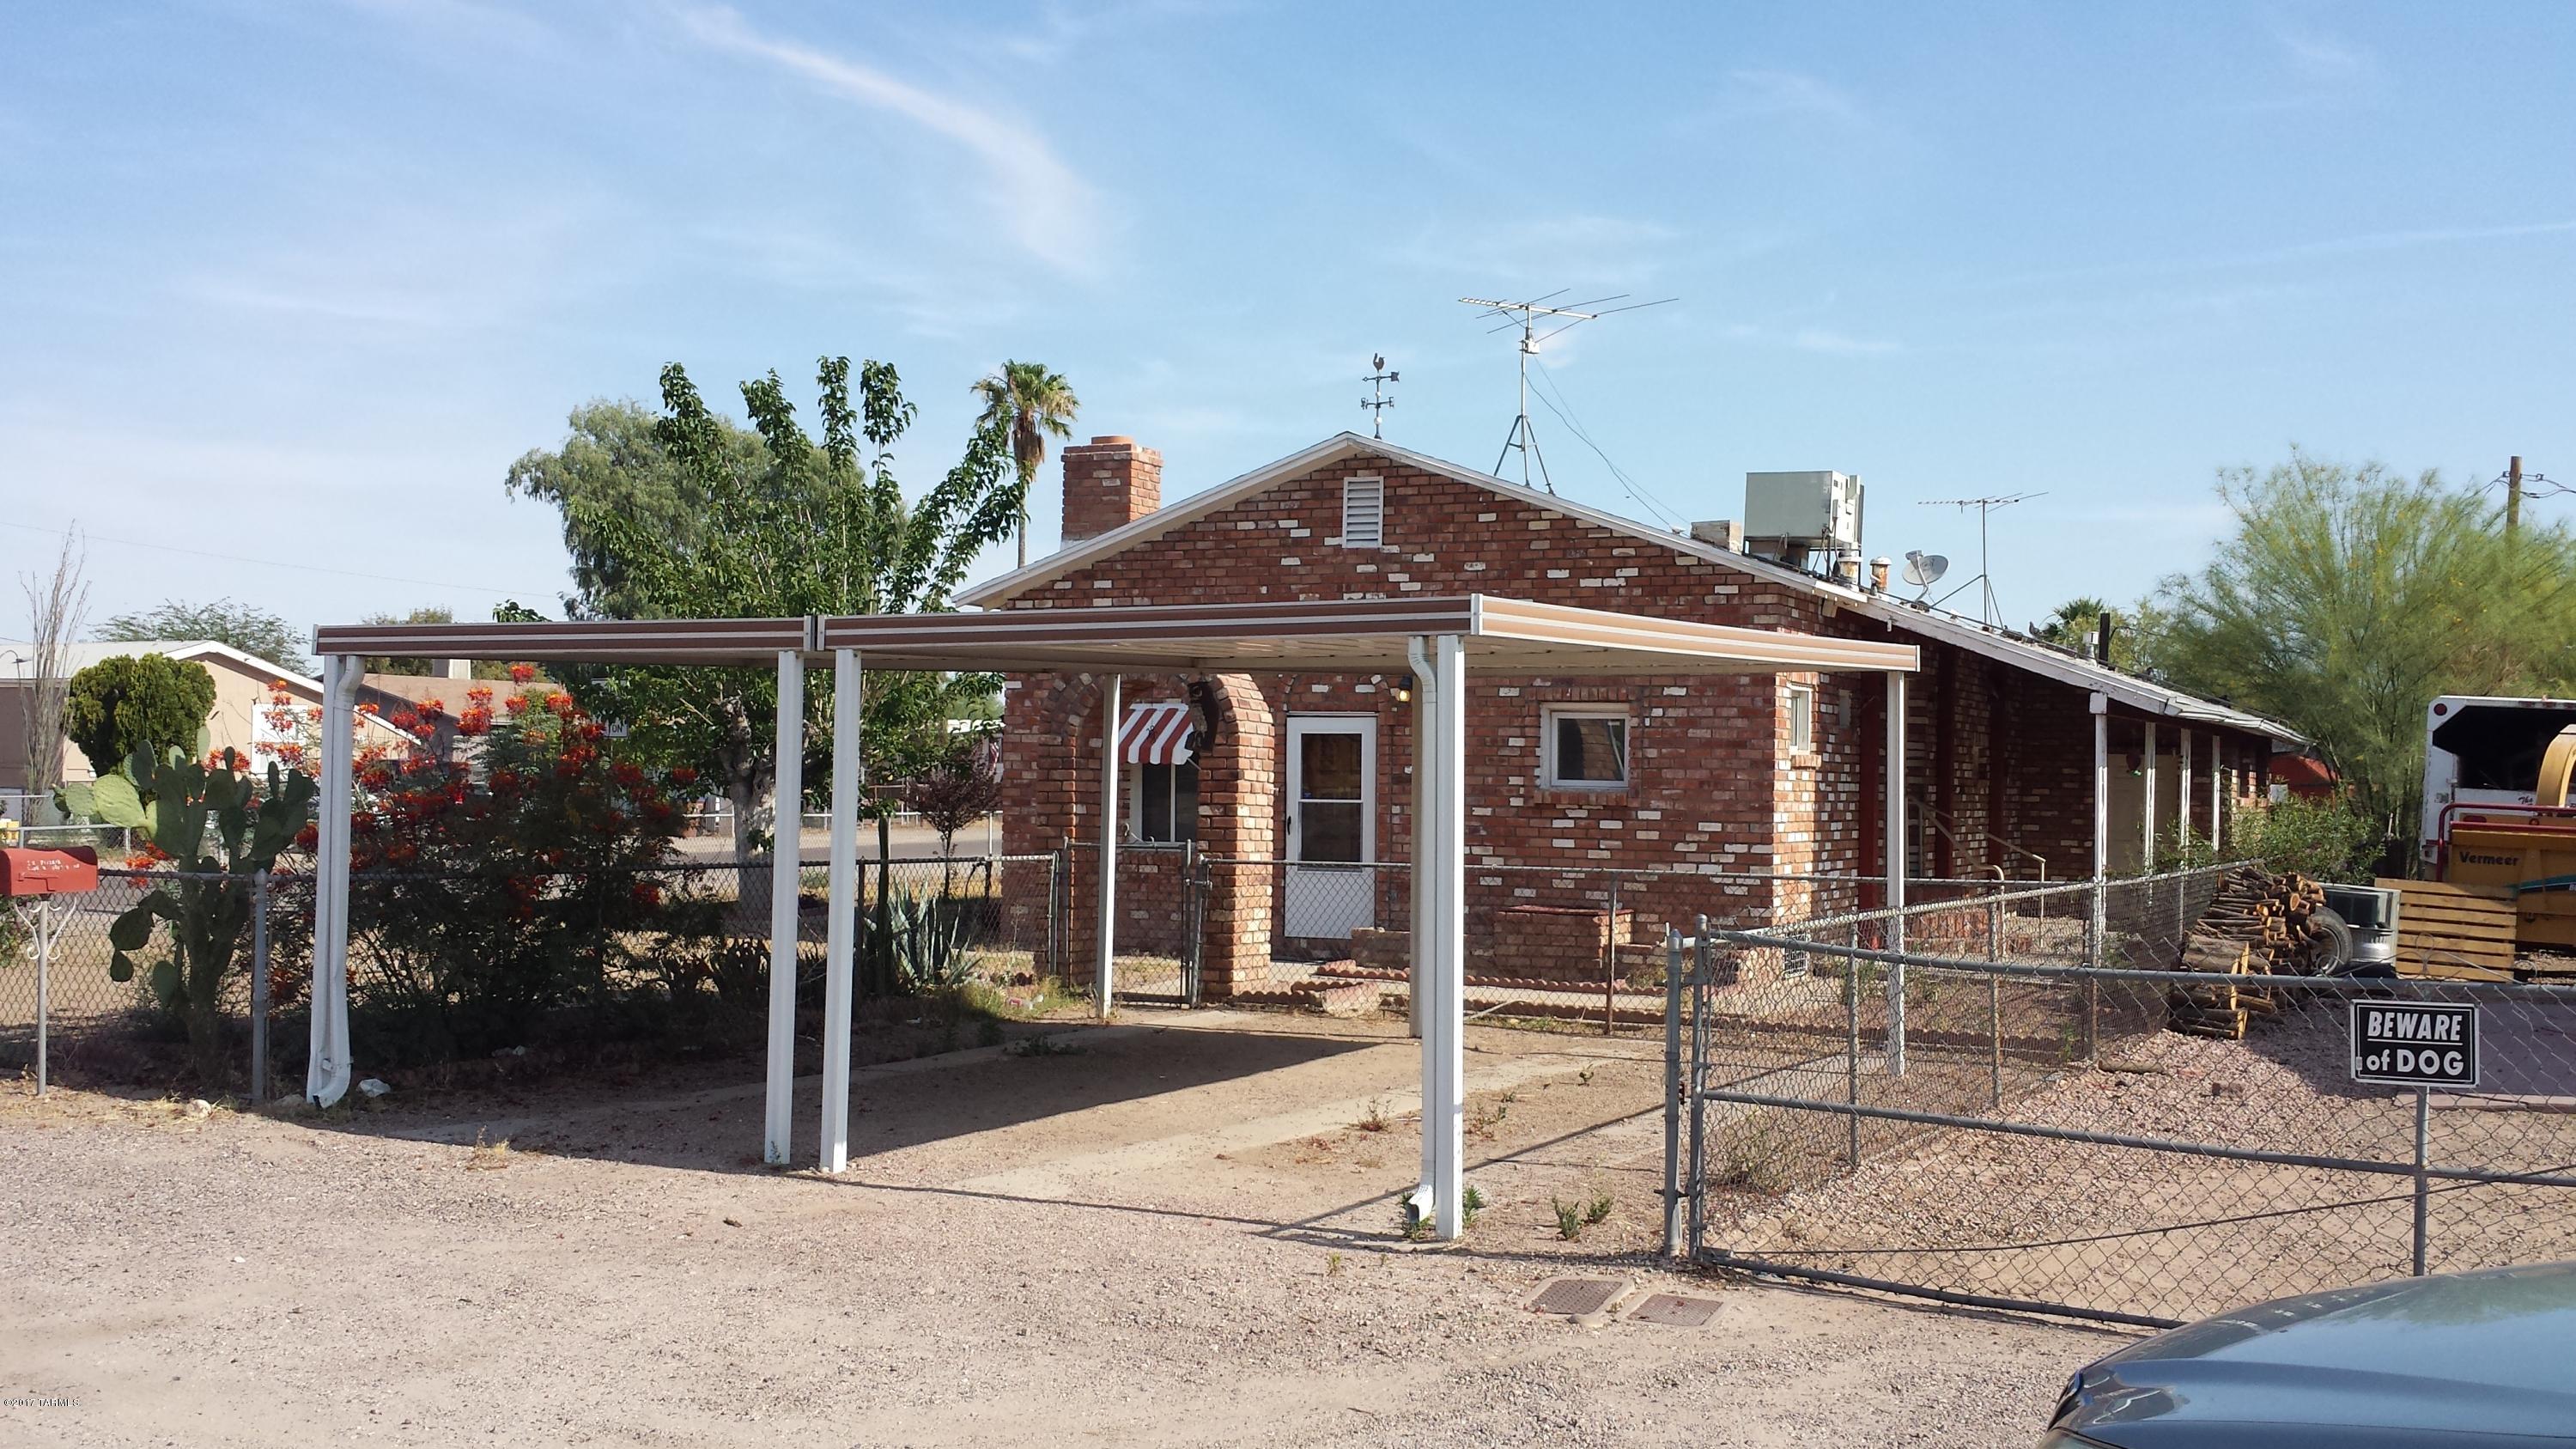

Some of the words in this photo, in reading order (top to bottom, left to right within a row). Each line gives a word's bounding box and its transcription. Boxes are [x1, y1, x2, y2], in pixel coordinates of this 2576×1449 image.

[2459, 851, 2518, 866] Vermeer
[2367, 1011, 2462, 1041] BEWARE
[2366, 1049, 2391, 1071] of
[2397, 1049, 2464, 1076] DOG
